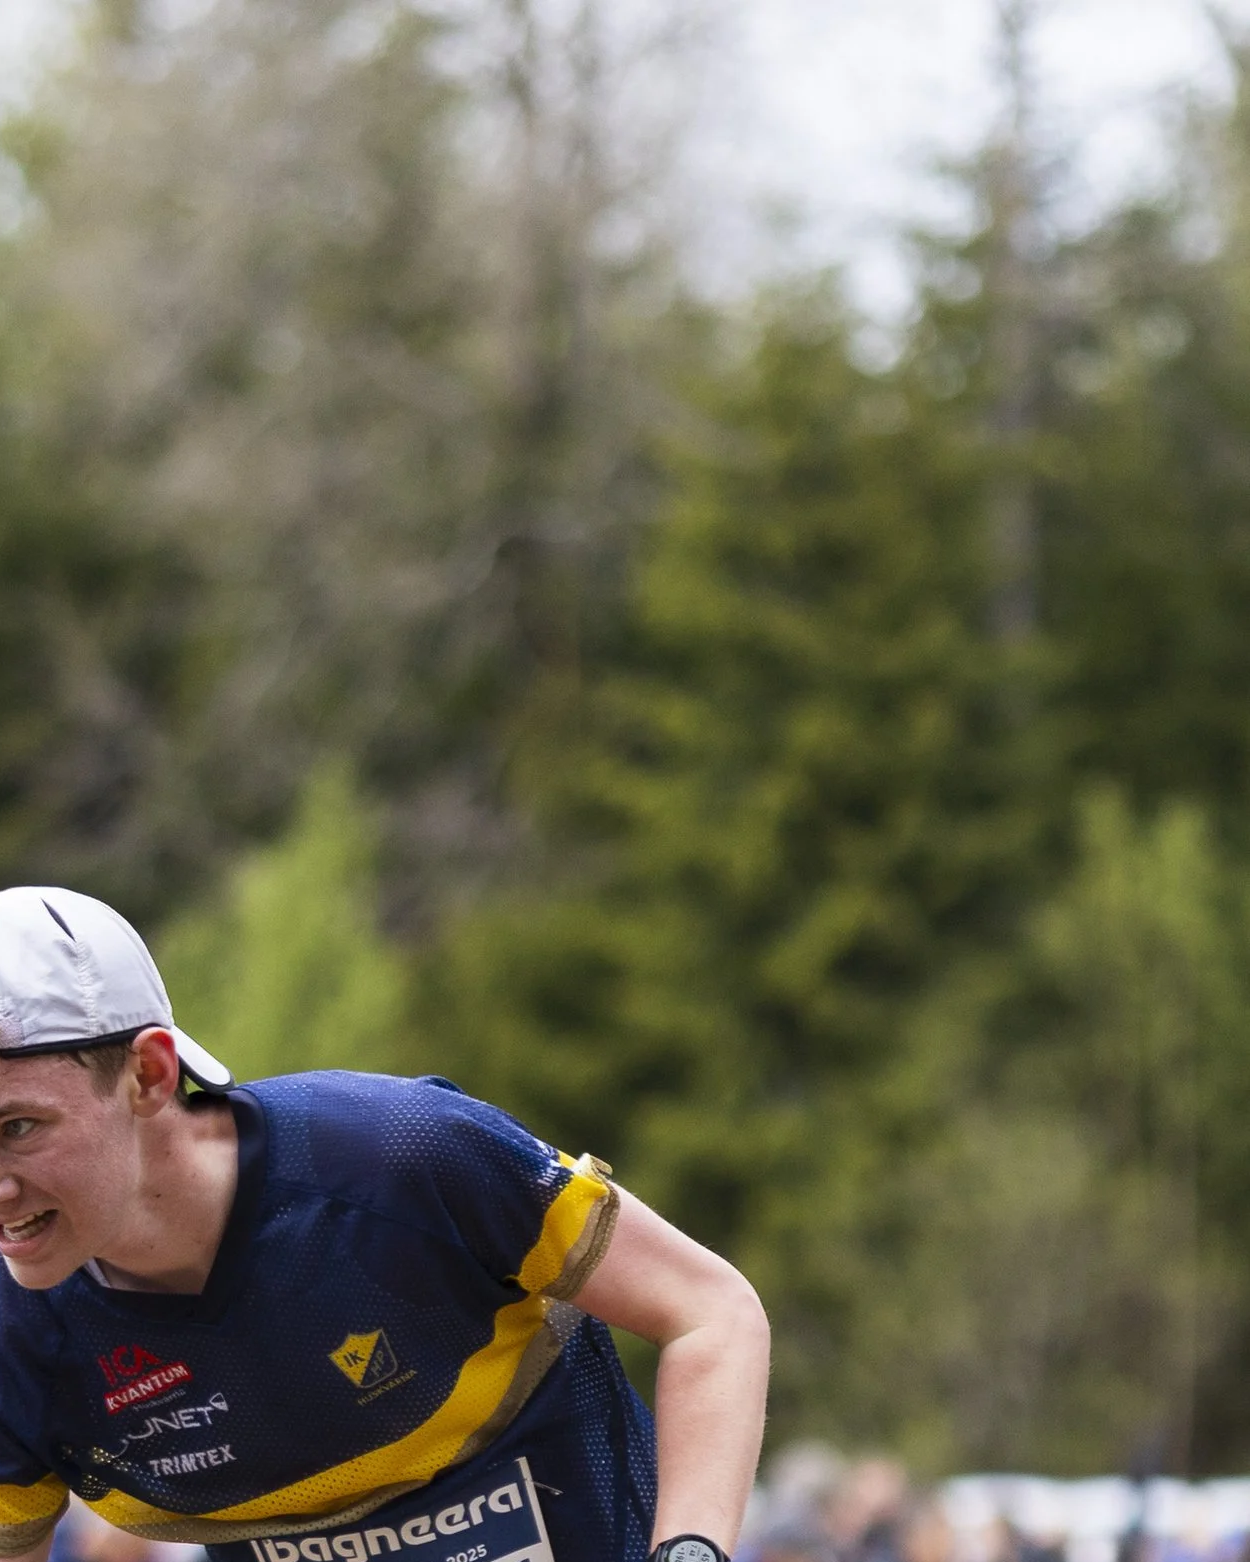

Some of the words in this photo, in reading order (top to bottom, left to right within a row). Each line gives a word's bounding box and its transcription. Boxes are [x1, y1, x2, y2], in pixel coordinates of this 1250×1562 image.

[97, 1343, 162, 1386] ICA
[105, 1364, 190, 1412] KVANTUM
[149, 1444, 238, 1478] TRIMTEX
